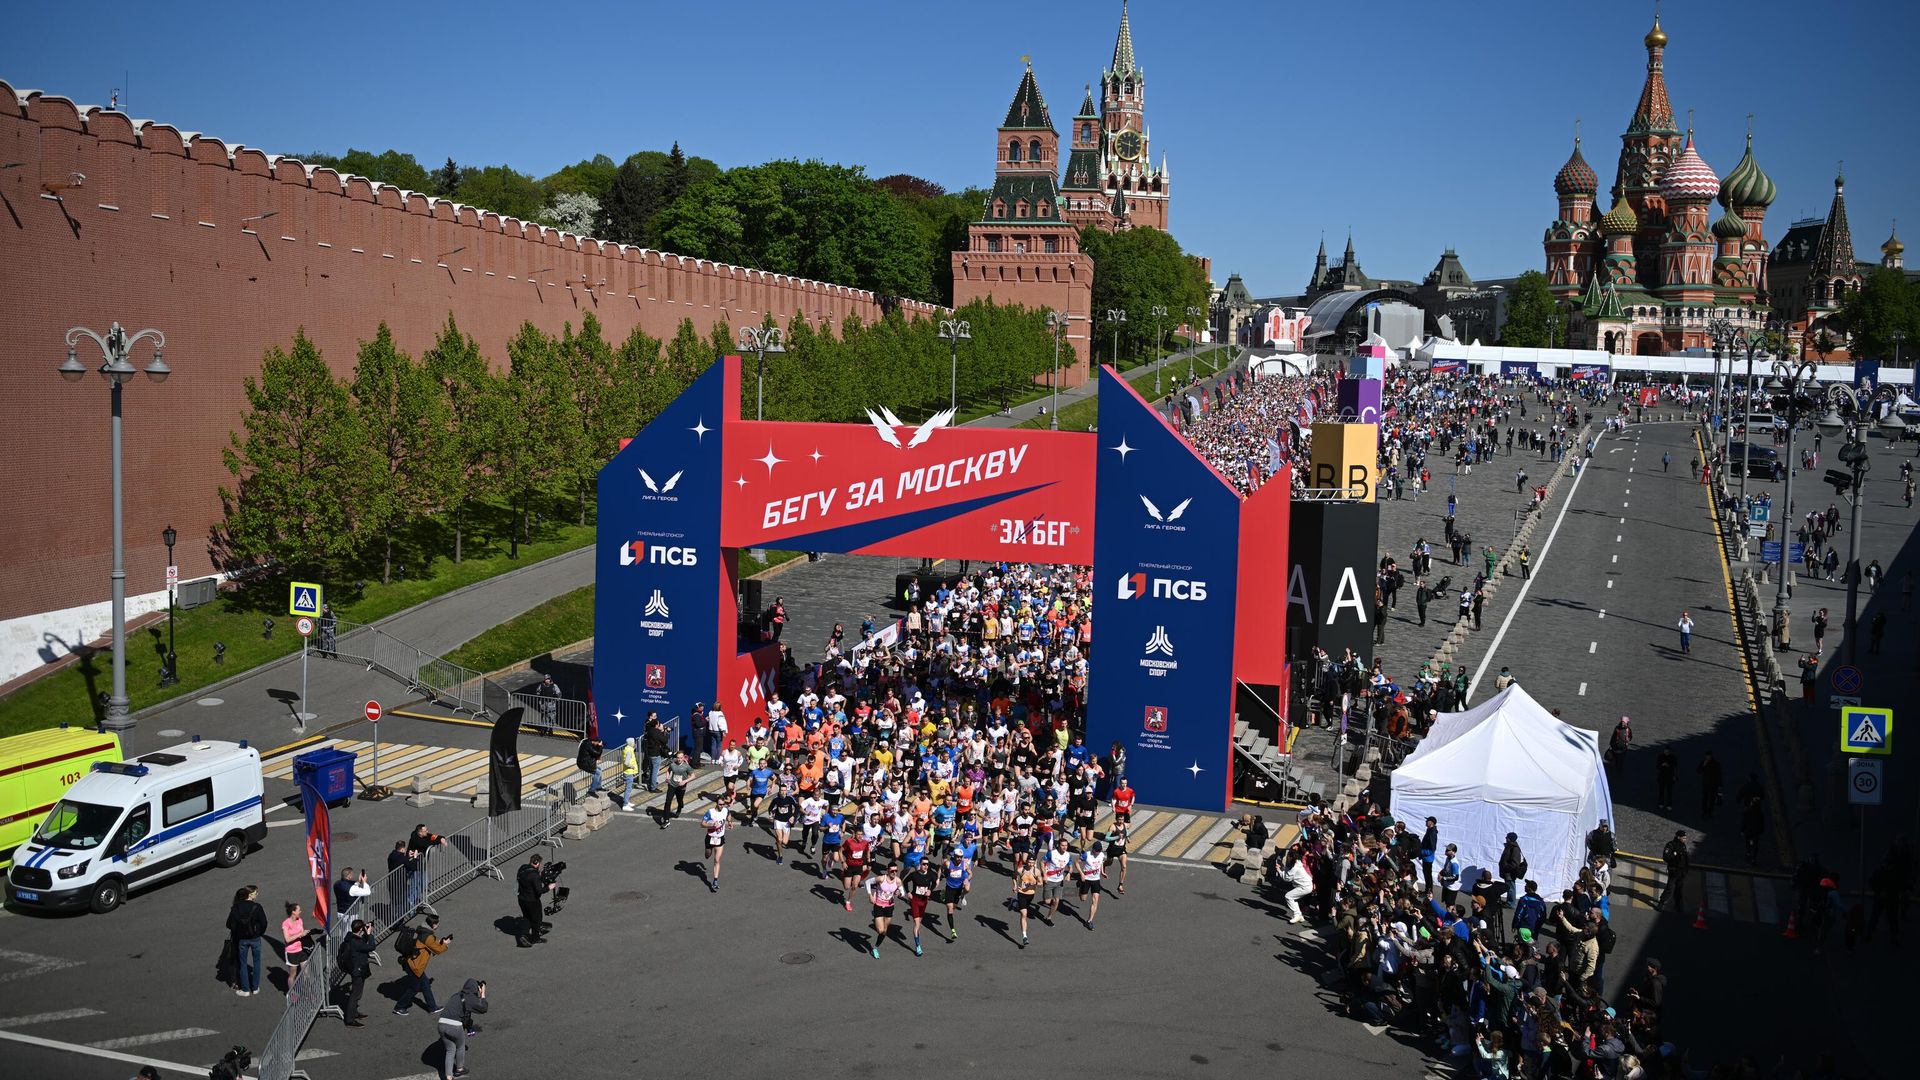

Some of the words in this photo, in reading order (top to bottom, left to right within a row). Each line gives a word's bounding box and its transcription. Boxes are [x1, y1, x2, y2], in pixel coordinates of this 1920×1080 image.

[762, 488, 837, 529] БЕГУ
[846, 477, 884, 511] ЗА
[896, 444, 1028, 499] МОСКВУ
[1349, 465, 1368, 500] B
[651, 545, 697, 566] ПСБ
[1153, 578, 1207, 601] ПСБ
[1326, 567, 1367, 625] A
[640, 620, 673, 630] МОСКОВСКИЙ
[648, 629, 664, 638] СПОРТ
[1140, 659, 1178, 670] МОСКОВСКИЙ
[1149, 668, 1167, 677] СПОРТ
[1140, 731, 1170, 739] Департамент
[60, 771, 81, 786] 103
[1858, 777, 1872, 787] 30
